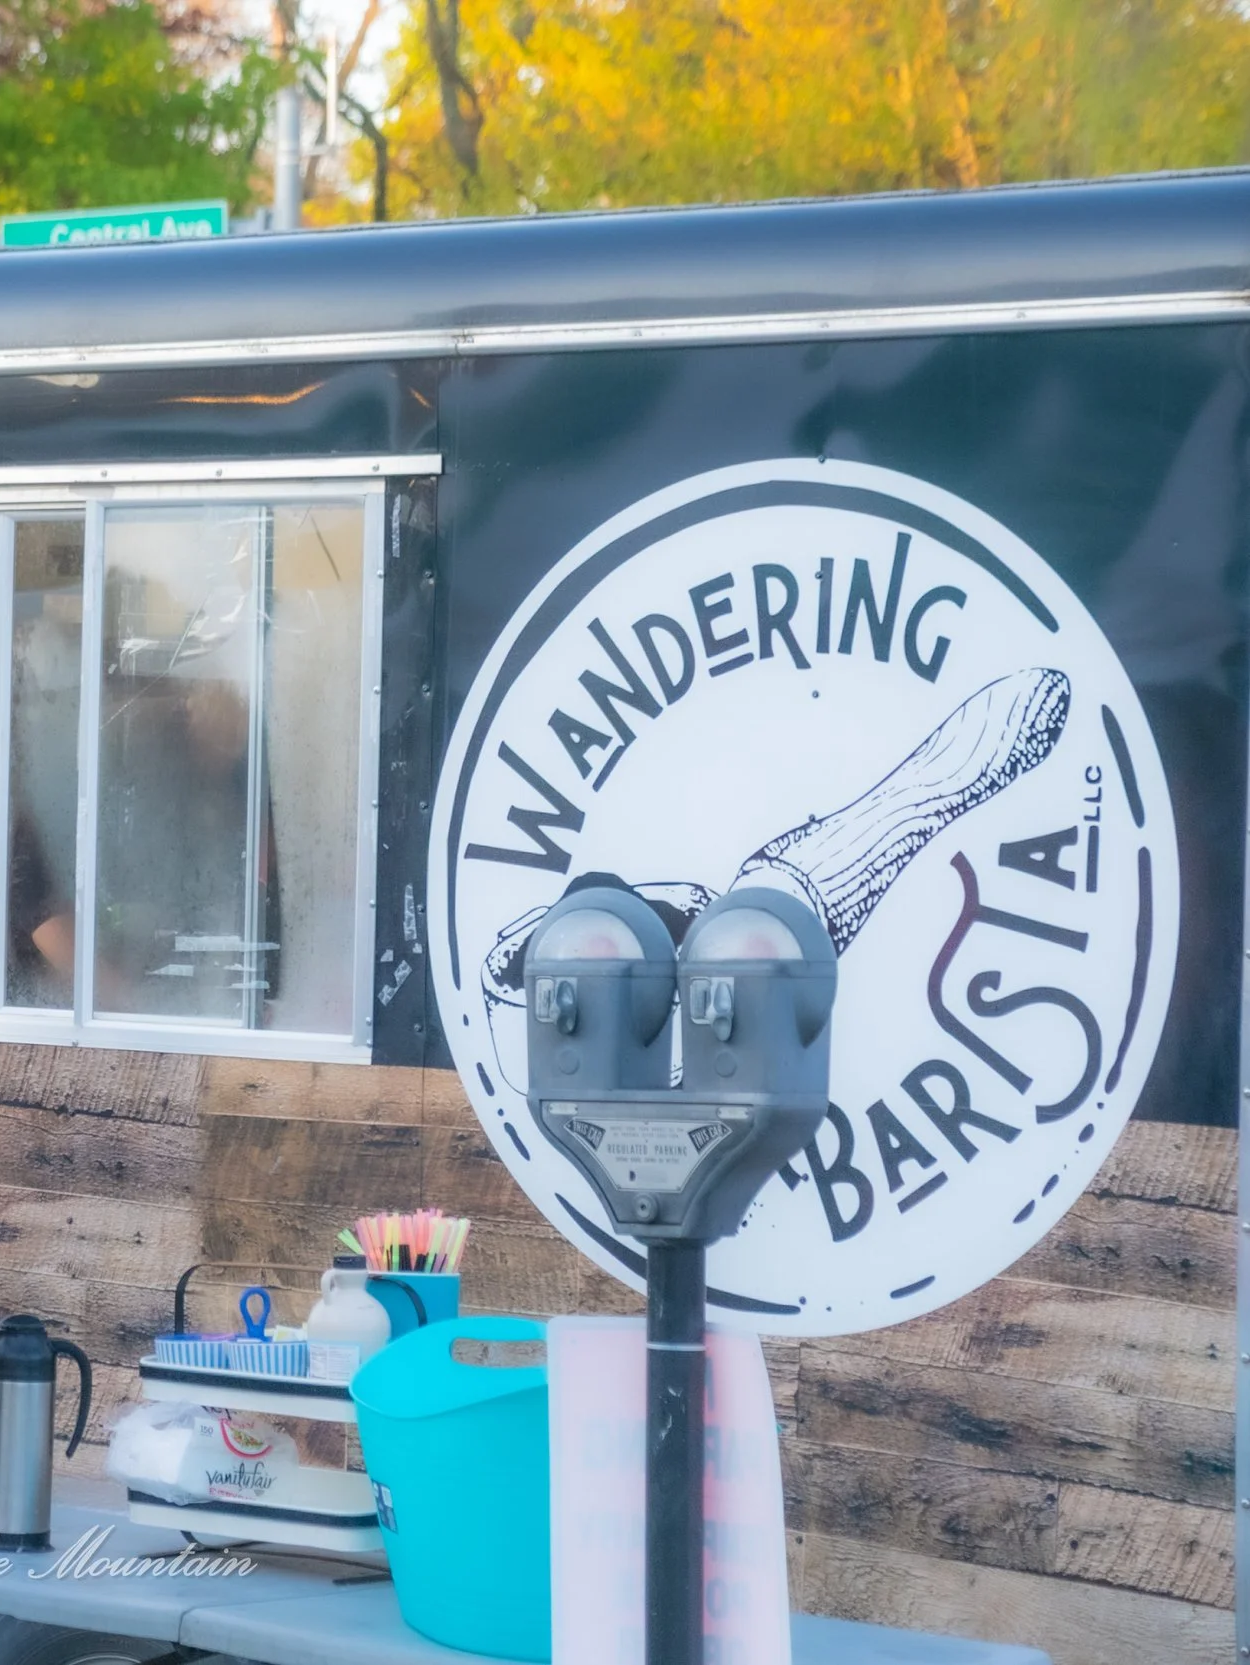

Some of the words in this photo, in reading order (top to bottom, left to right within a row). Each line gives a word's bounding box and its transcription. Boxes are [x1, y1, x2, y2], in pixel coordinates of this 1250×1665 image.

[51, 219, 149, 245] Central
[160, 216, 212, 239] Ave
[464, 532, 967, 875] WANDERING
[803, 825, 1102, 1242] BARISTA
[1083, 765, 1102, 822] LLC
[607, 1143, 648, 1155] REGULATED
[654, 1144, 688, 1157] PARKING
